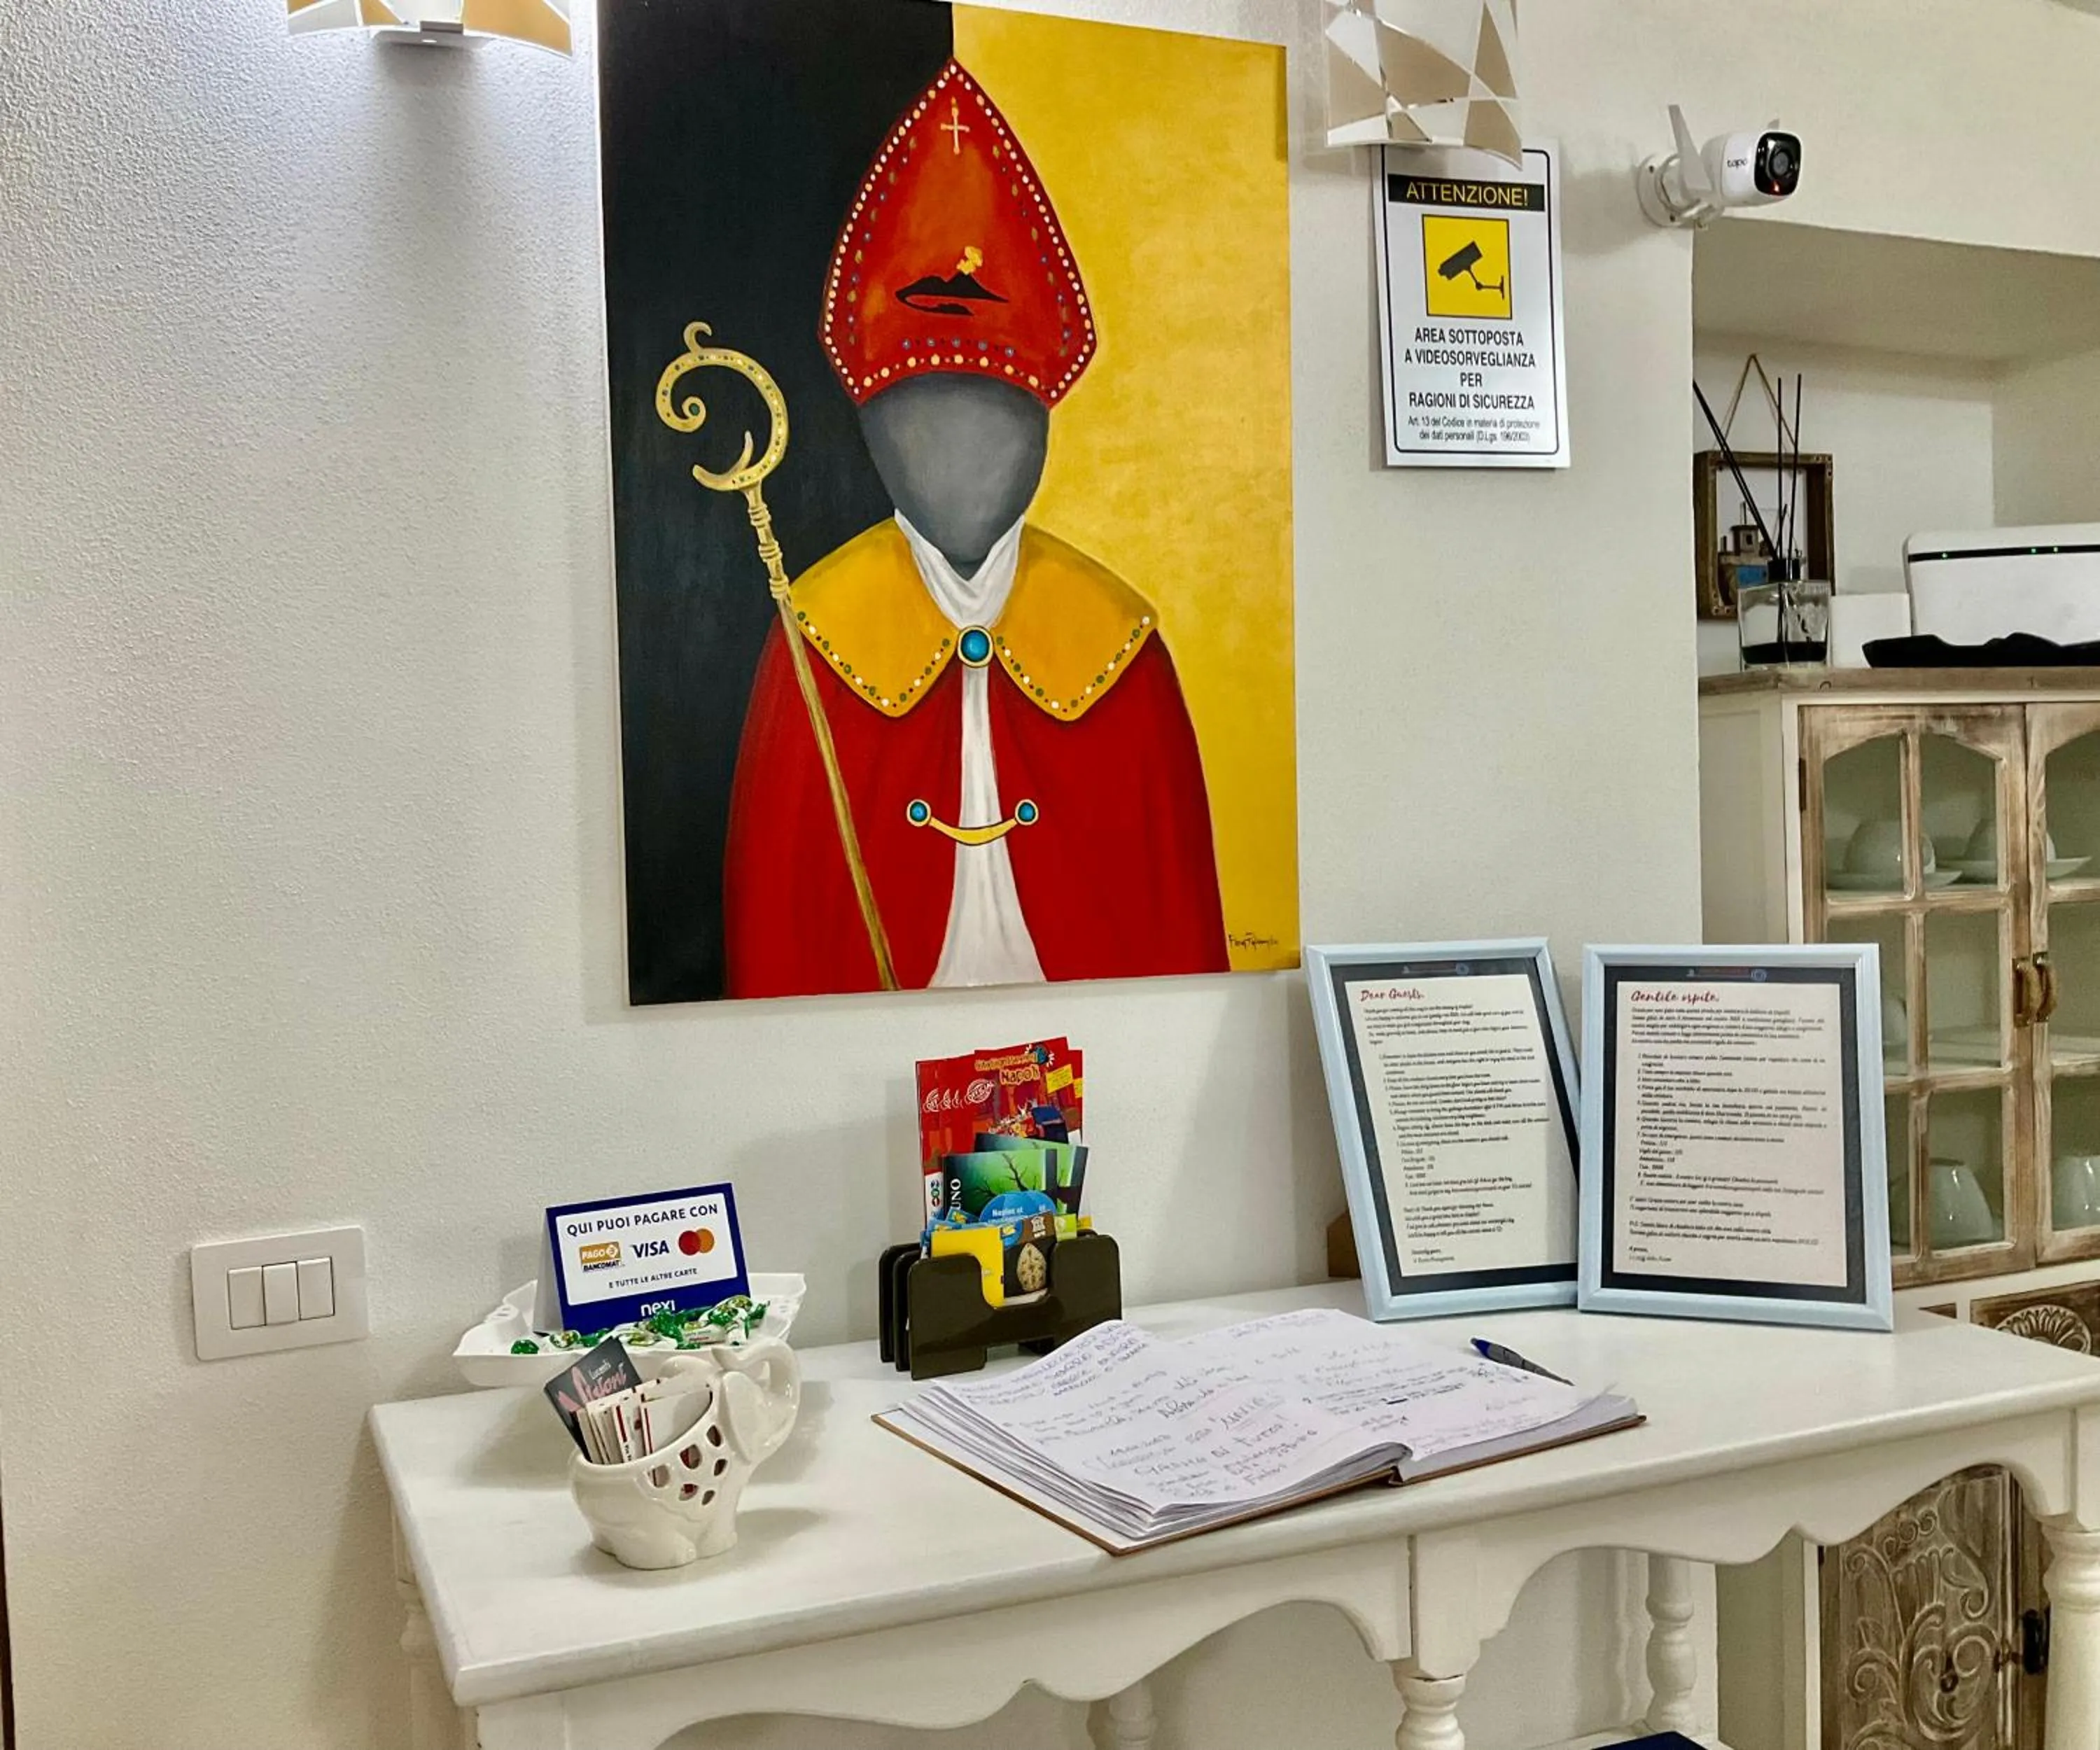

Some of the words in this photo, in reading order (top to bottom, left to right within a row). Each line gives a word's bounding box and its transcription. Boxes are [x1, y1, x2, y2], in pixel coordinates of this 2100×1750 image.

[1727, 158, 1747, 169] tapo
[1406, 181, 1529, 206] ATTENZIONE!
[1415, 327, 1446, 343] AREA
[1448, 328, 1524, 346] SOTTOPOSTA
[1404, 348, 1413, 364] A
[1415, 349, 1536, 368] VIDEOSORVEGLIANZA
[1460, 372, 1483, 387] PER
[1409, 391, 1456, 408] RAGIONI
[1460, 393, 1470, 408] DI
[1473, 393, 1535, 410] SICUREZZA
[1431, 416, 1441, 426] del
[1442, 416, 1465, 427] Codice
[1444, 430, 1475, 442] personali
[1360, 989, 1385, 1002] Dear
[1630, 990, 1678, 1002] Gentile
[566, 1222, 593, 1237] QUI
[597, 1217, 631, 1231] PUOI
[634, 1208, 687, 1226] PAGARE
[690, 1203, 719, 1217] CON
[581, 1249, 606, 1260] PAGO
[632, 1240, 670, 1259] VISA
[582, 1259, 620, 1272] BANCOMAT
[616, 1278, 639, 1288] TUTTE
[640, 1275, 649, 1284] LE
[651, 1270, 673, 1282] ALTRE
[674, 1268, 698, 1278] CARTE
